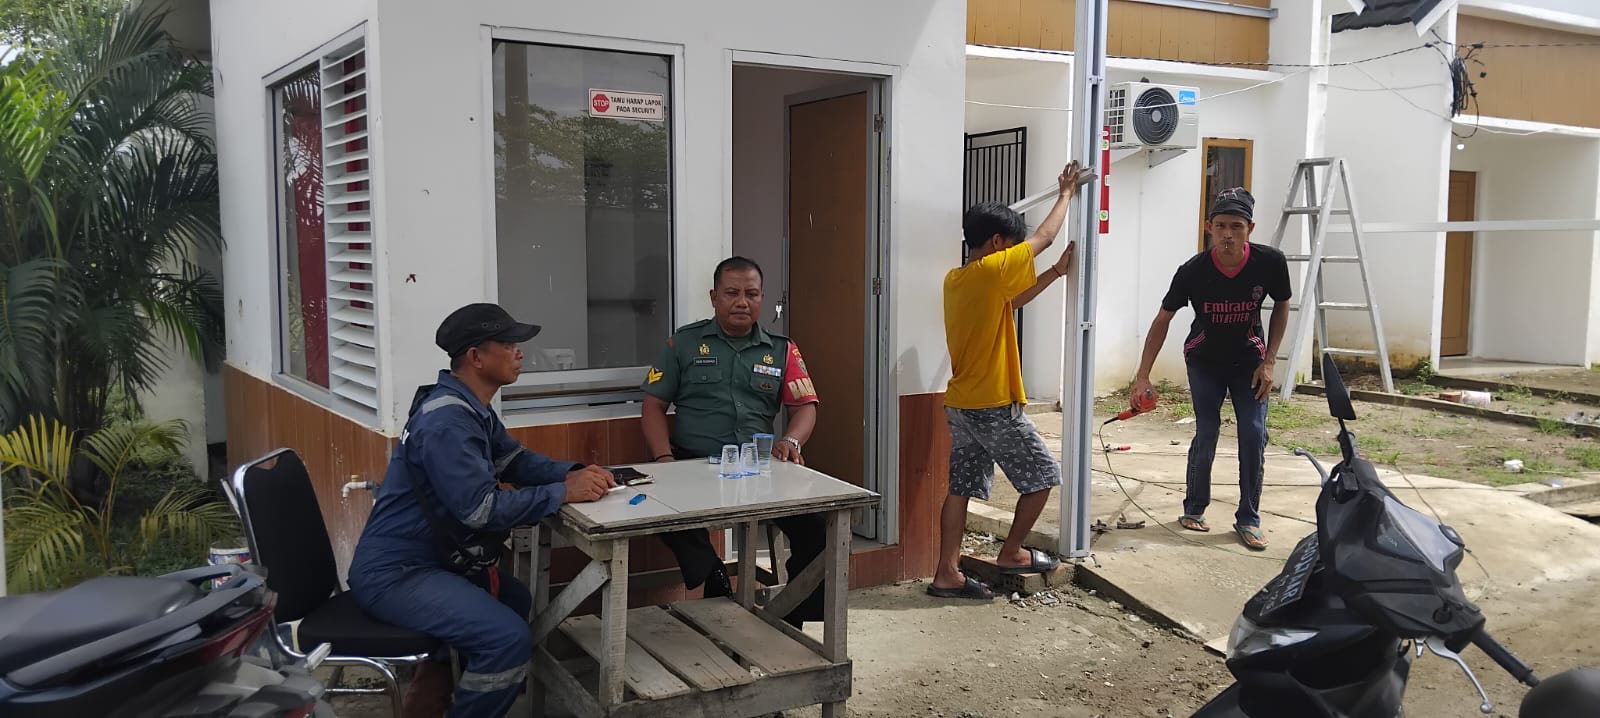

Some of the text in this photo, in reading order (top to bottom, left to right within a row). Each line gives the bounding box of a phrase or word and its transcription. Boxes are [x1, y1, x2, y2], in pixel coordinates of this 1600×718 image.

[593, 99, 609, 107] STOP
[611, 96, 662, 107] TAMU HARAP LAPOR
[616, 105, 656, 115] PADA SECURITY
[1203, 300, 1258, 314] Emirates
[1212, 312, 1250, 324] FLY BETTER
